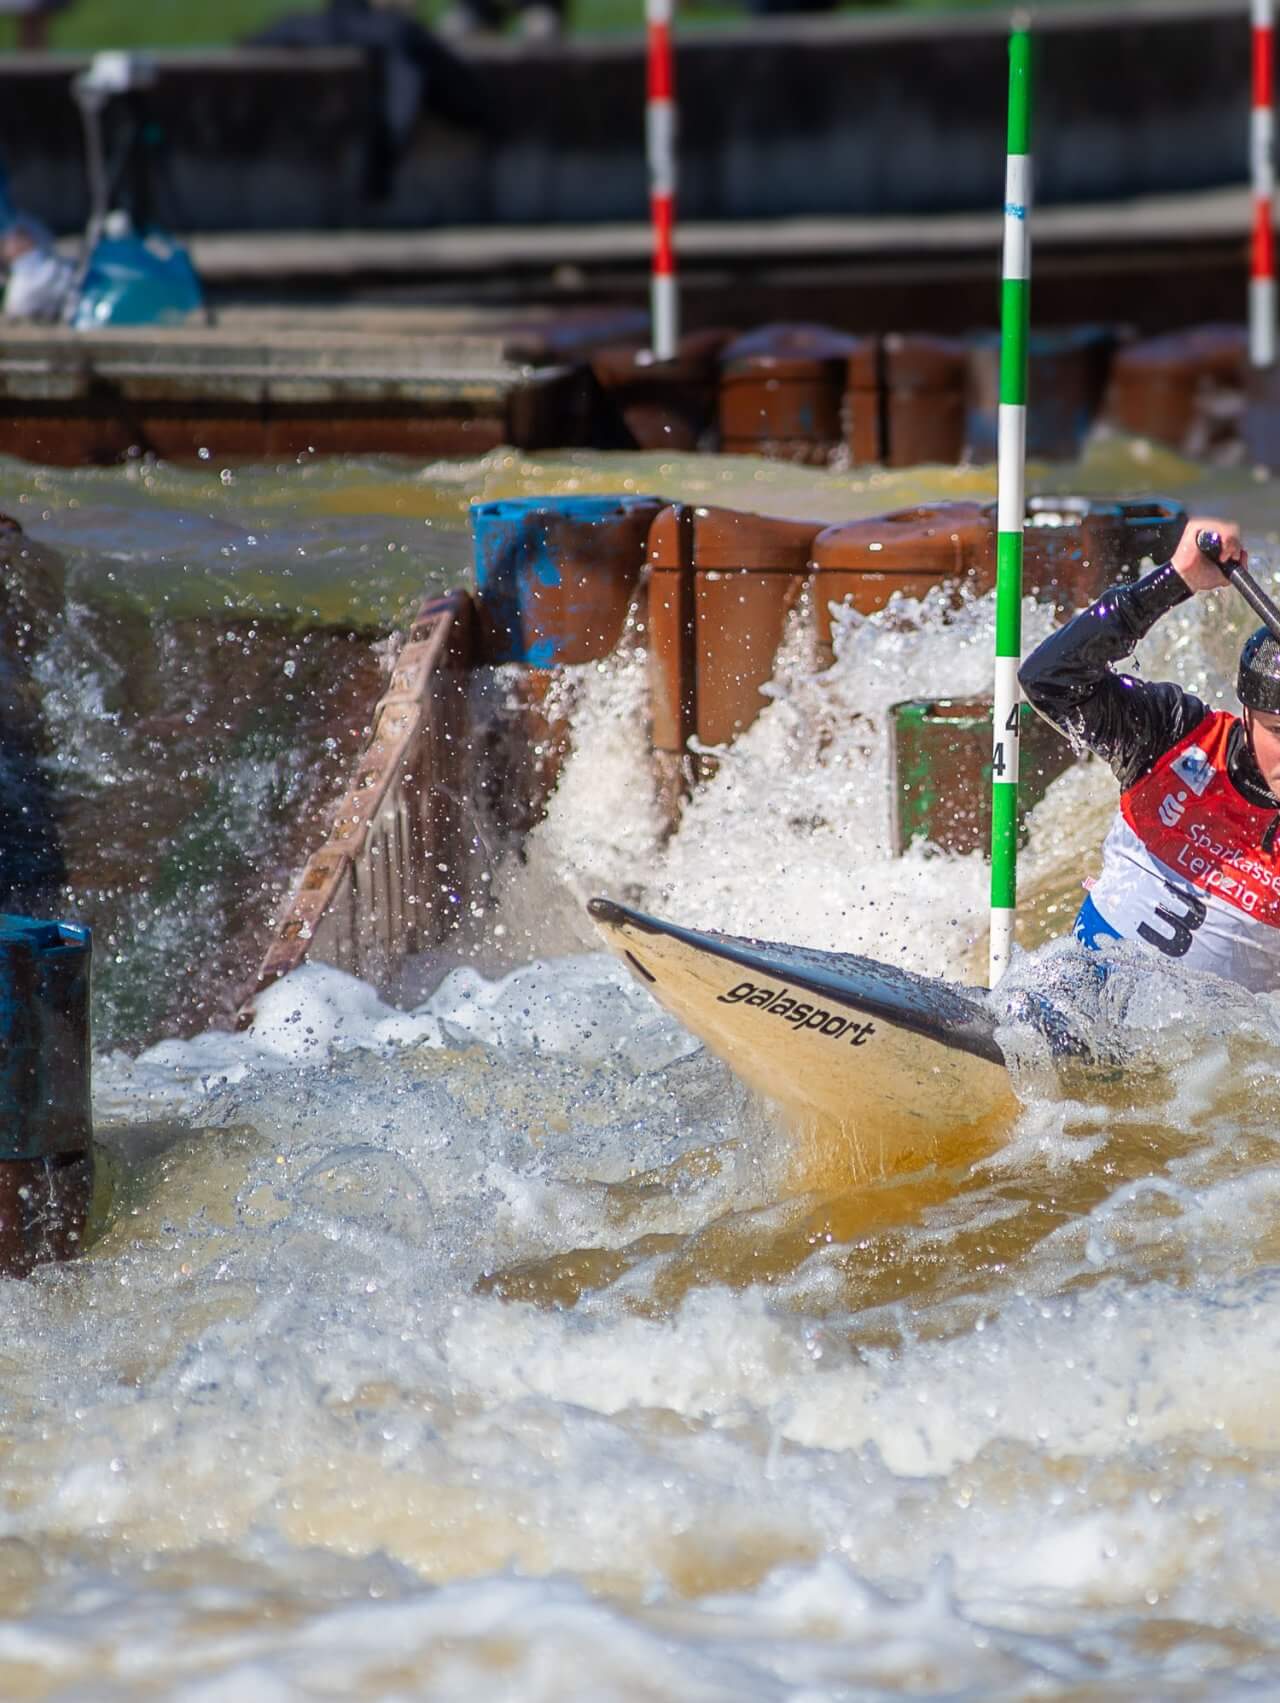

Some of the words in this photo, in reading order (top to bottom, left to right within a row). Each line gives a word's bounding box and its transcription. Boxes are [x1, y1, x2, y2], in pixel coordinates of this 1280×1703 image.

[1005, 703, 1019, 737] 4
[992, 742, 1006, 776] 4
[1177, 843, 1258, 911] Leipzig
[1136, 880, 1207, 958] 3
[716, 982, 876, 1046] galasport
